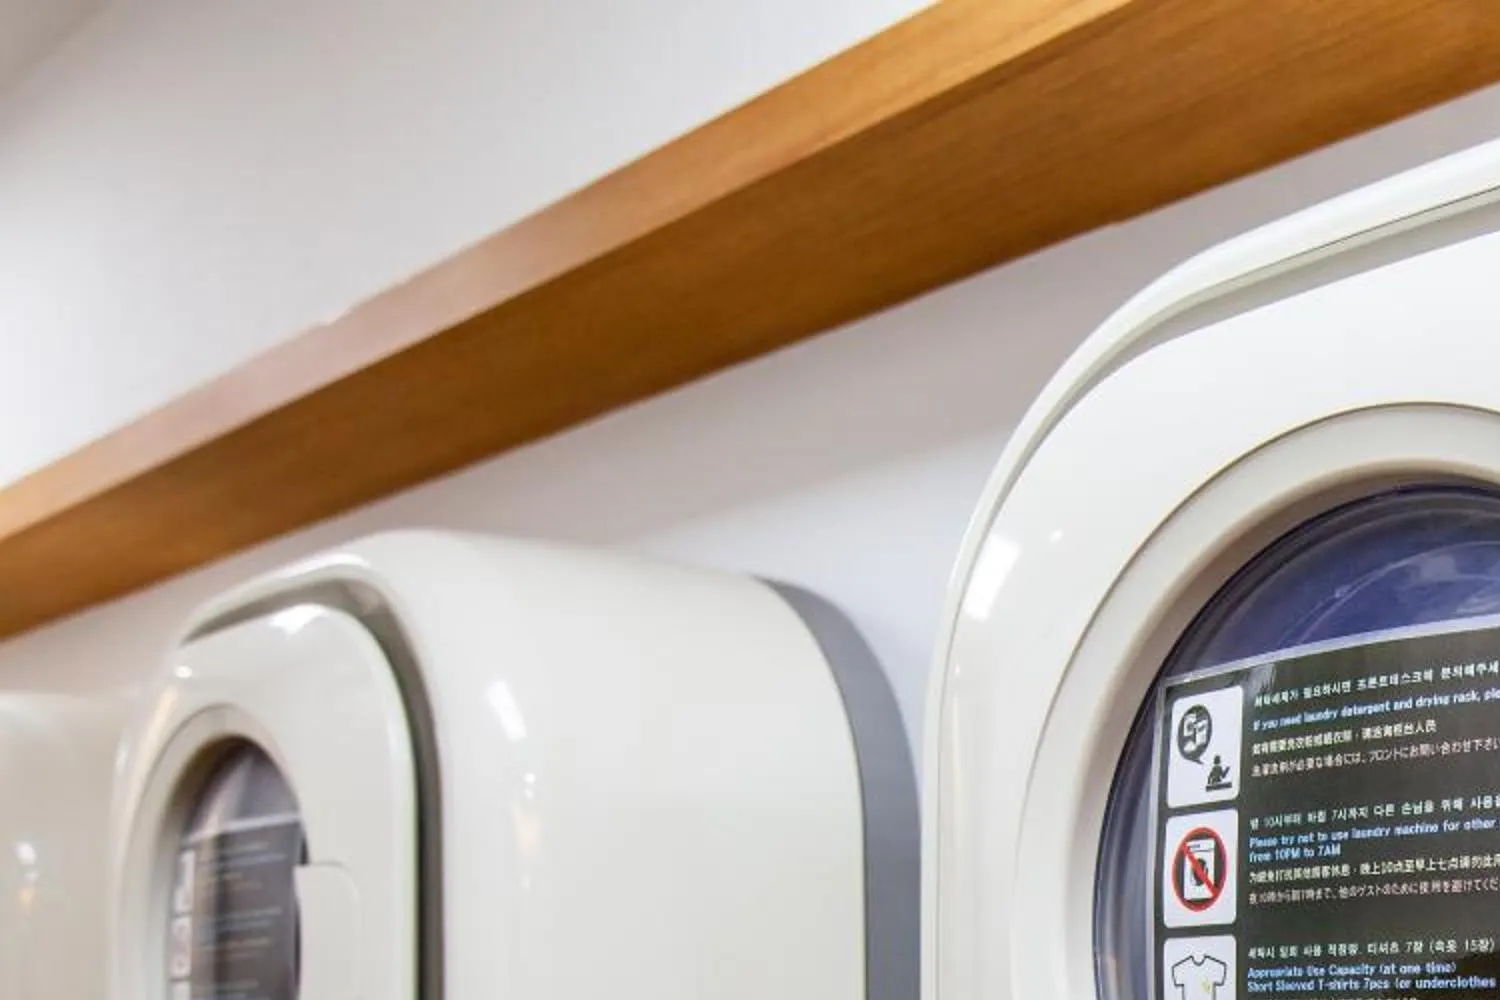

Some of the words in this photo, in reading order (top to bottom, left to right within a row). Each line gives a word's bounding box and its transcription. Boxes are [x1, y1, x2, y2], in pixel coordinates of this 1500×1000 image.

[1304, 709, 1338, 723] laundry
[1341, 700, 1391, 717] detergent
[1393, 697, 1413, 710] and
[1415, 693, 1450, 709] drying
[1373, 803, 1395, 817] 다른
[1401, 799, 1434, 815] 손님을
[1250, 836, 1278, 848] Please
[1281, 834, 1294, 846] try
[1297, 832, 1314, 844] not
[1317, 831, 1328, 841] to
[1331, 831, 1349, 840] use
[1352, 826, 1390, 839] laundry
[1394, 822, 1439, 836] machine
[1442, 819, 1460, 832] for
[1464, 817, 1496, 830] other
[1249, 851, 1271, 863] from
[1275, 849, 1300, 861] 10PM
[1304, 848, 1315, 858] to
[1318, 843, 1341, 857] 7AM
[1248, 966, 1303, 979] Appropriate
[1307, 965, 1325, 977] Use
[1329, 963, 1376, 977] Capacity
[1400, 964, 1421, 974] one
[1248, 980, 1273, 992] Short
[1275, 979, 1314, 991] Sleeved
[1318, 978, 1360, 991] T-shirts
[1364, 978, 1390, 991] 7pcs
[1415, 975, 1497, 989] underclothes
